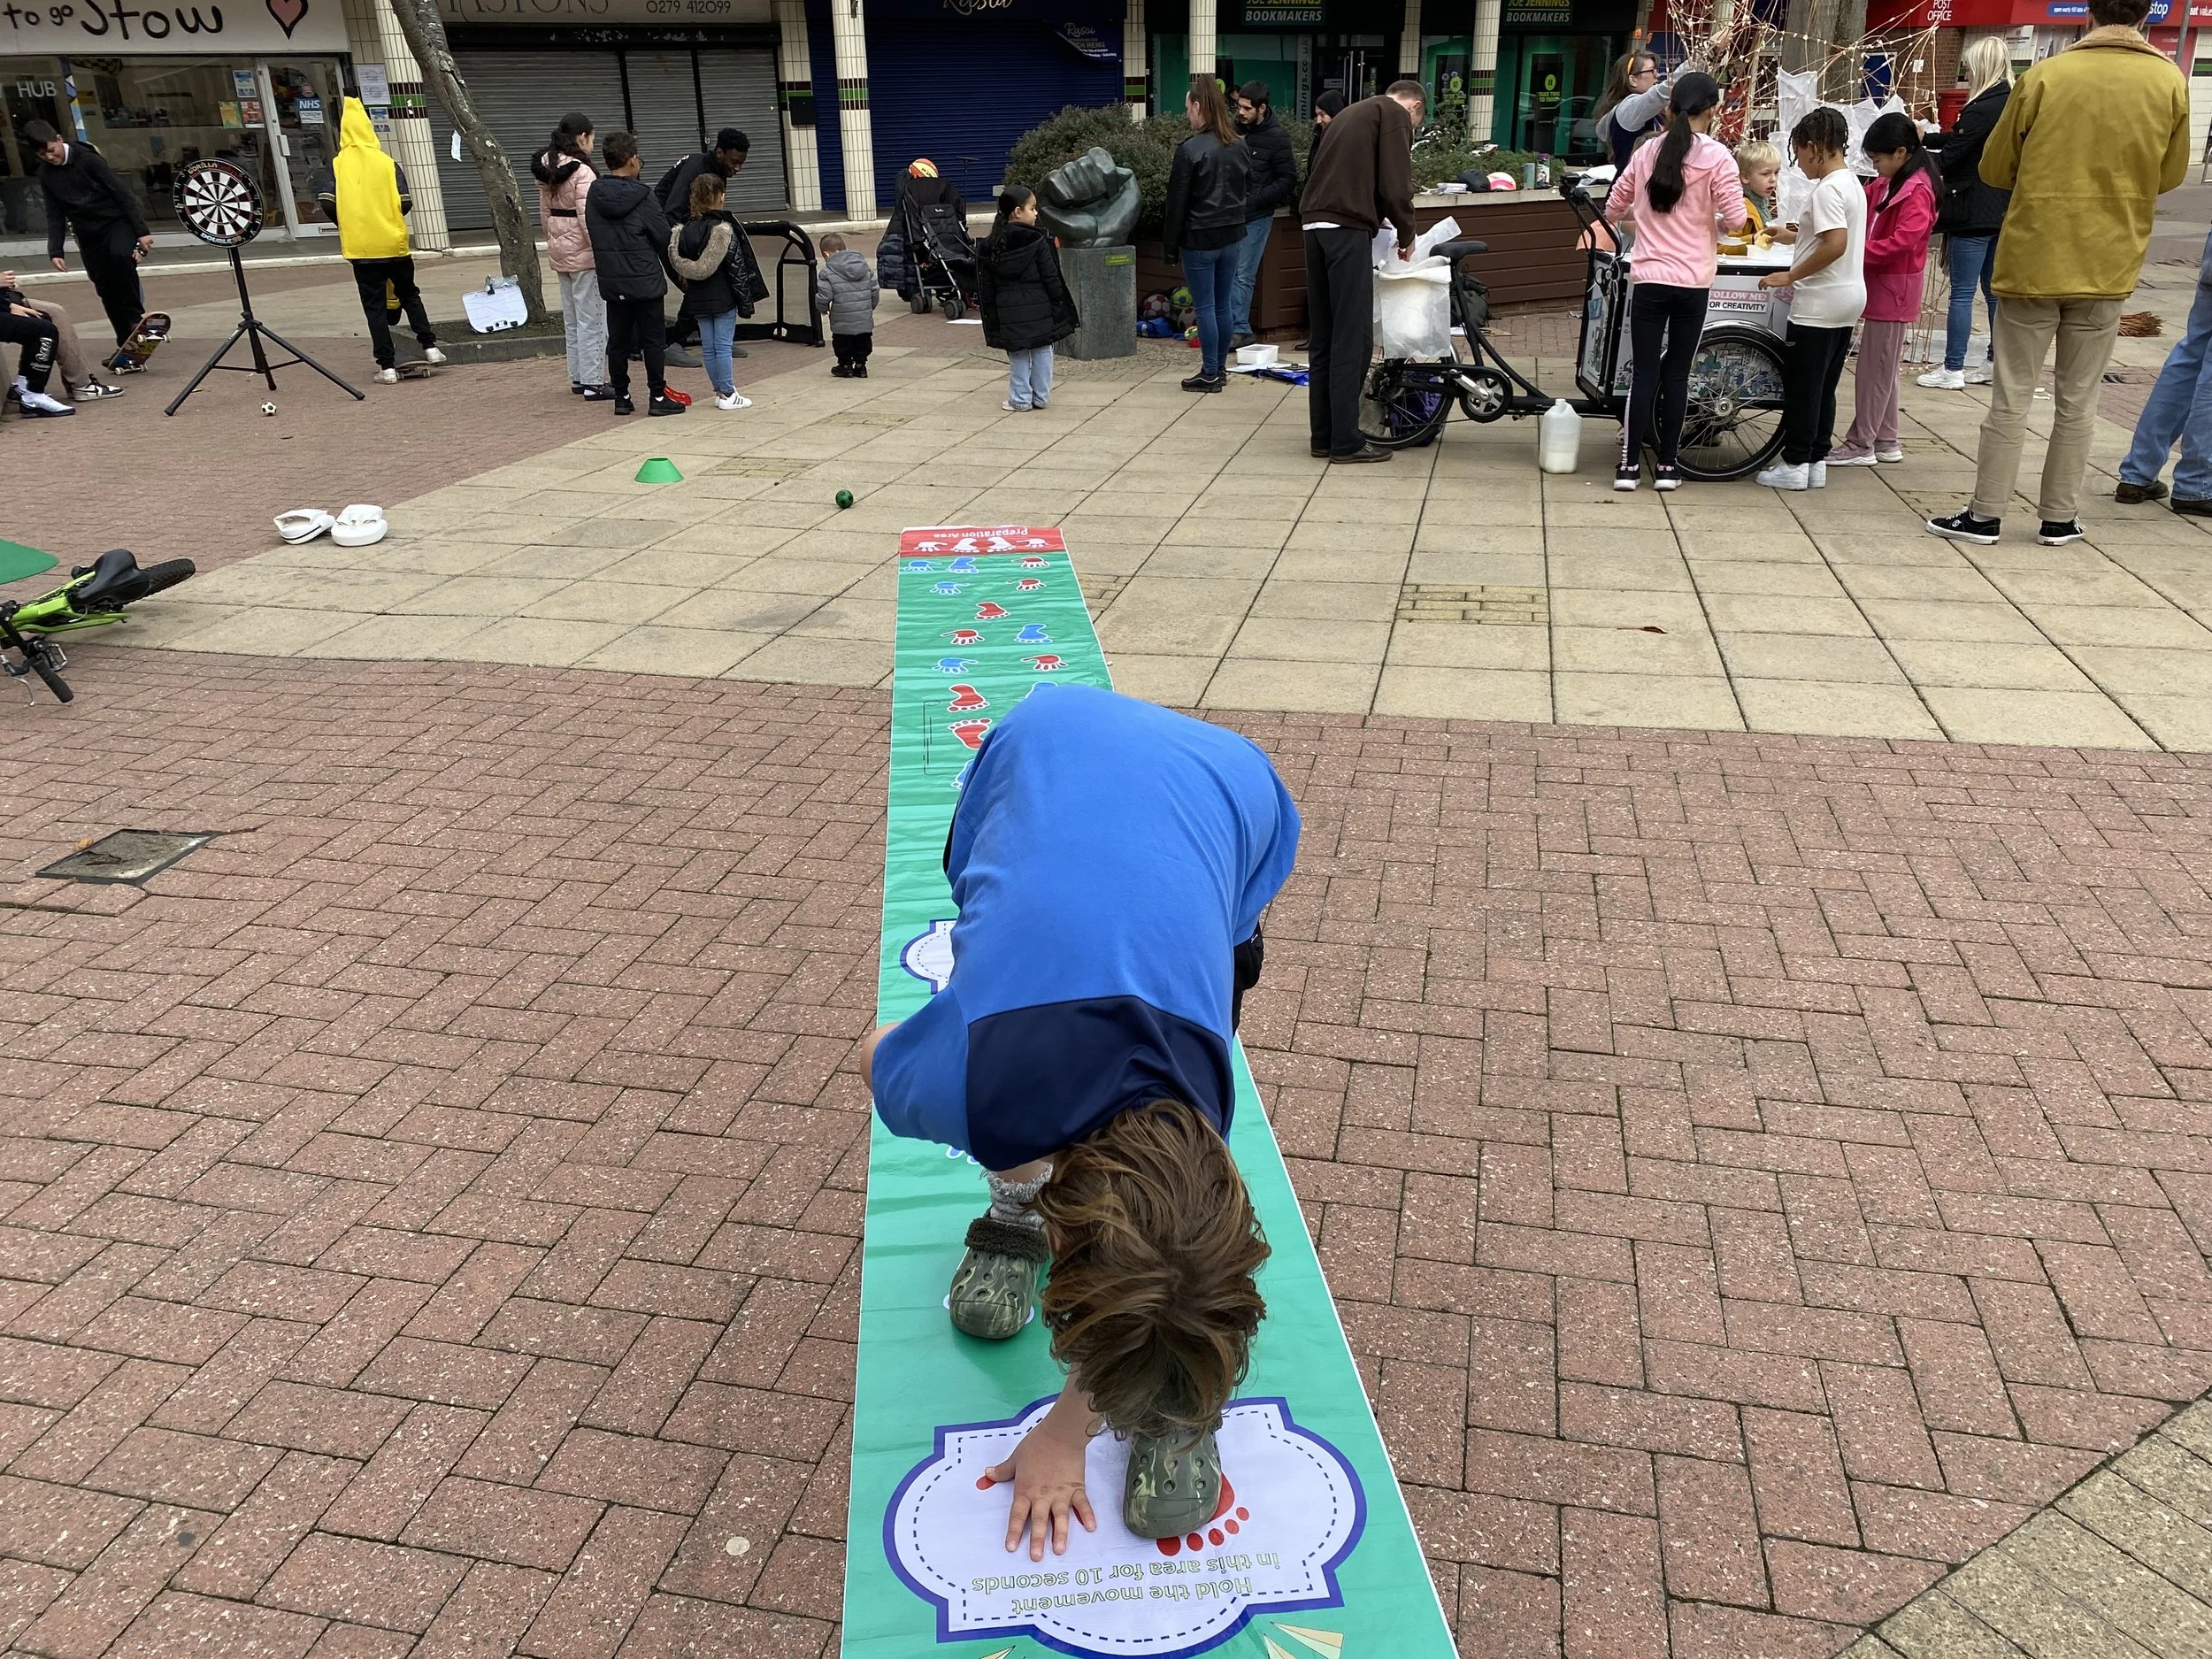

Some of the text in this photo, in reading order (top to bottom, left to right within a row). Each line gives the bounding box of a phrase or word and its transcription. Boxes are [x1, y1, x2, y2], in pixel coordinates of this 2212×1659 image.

[3, 3, 41, 29] to
[49, 4, 73, 27] go
[1245, 11, 1323, 21] BOOKMAKERS
[1506, 12, 1571, 22] BOOKMAKERS
[1927, 11, 1952, 21] OFFICE
[17, 81, 58, 98] HUB
[299, 99, 320, 109] NHS
[1709, 290, 1747, 299] FOLLOW
[1722, 302, 1766, 311] CREATIVITY
[962, 527, 1028, 538] Preparation
[972, 1552, 1279, 1594] in this area for 10 seconds
[1012, 1578, 1253, 1615] Hold the movement
